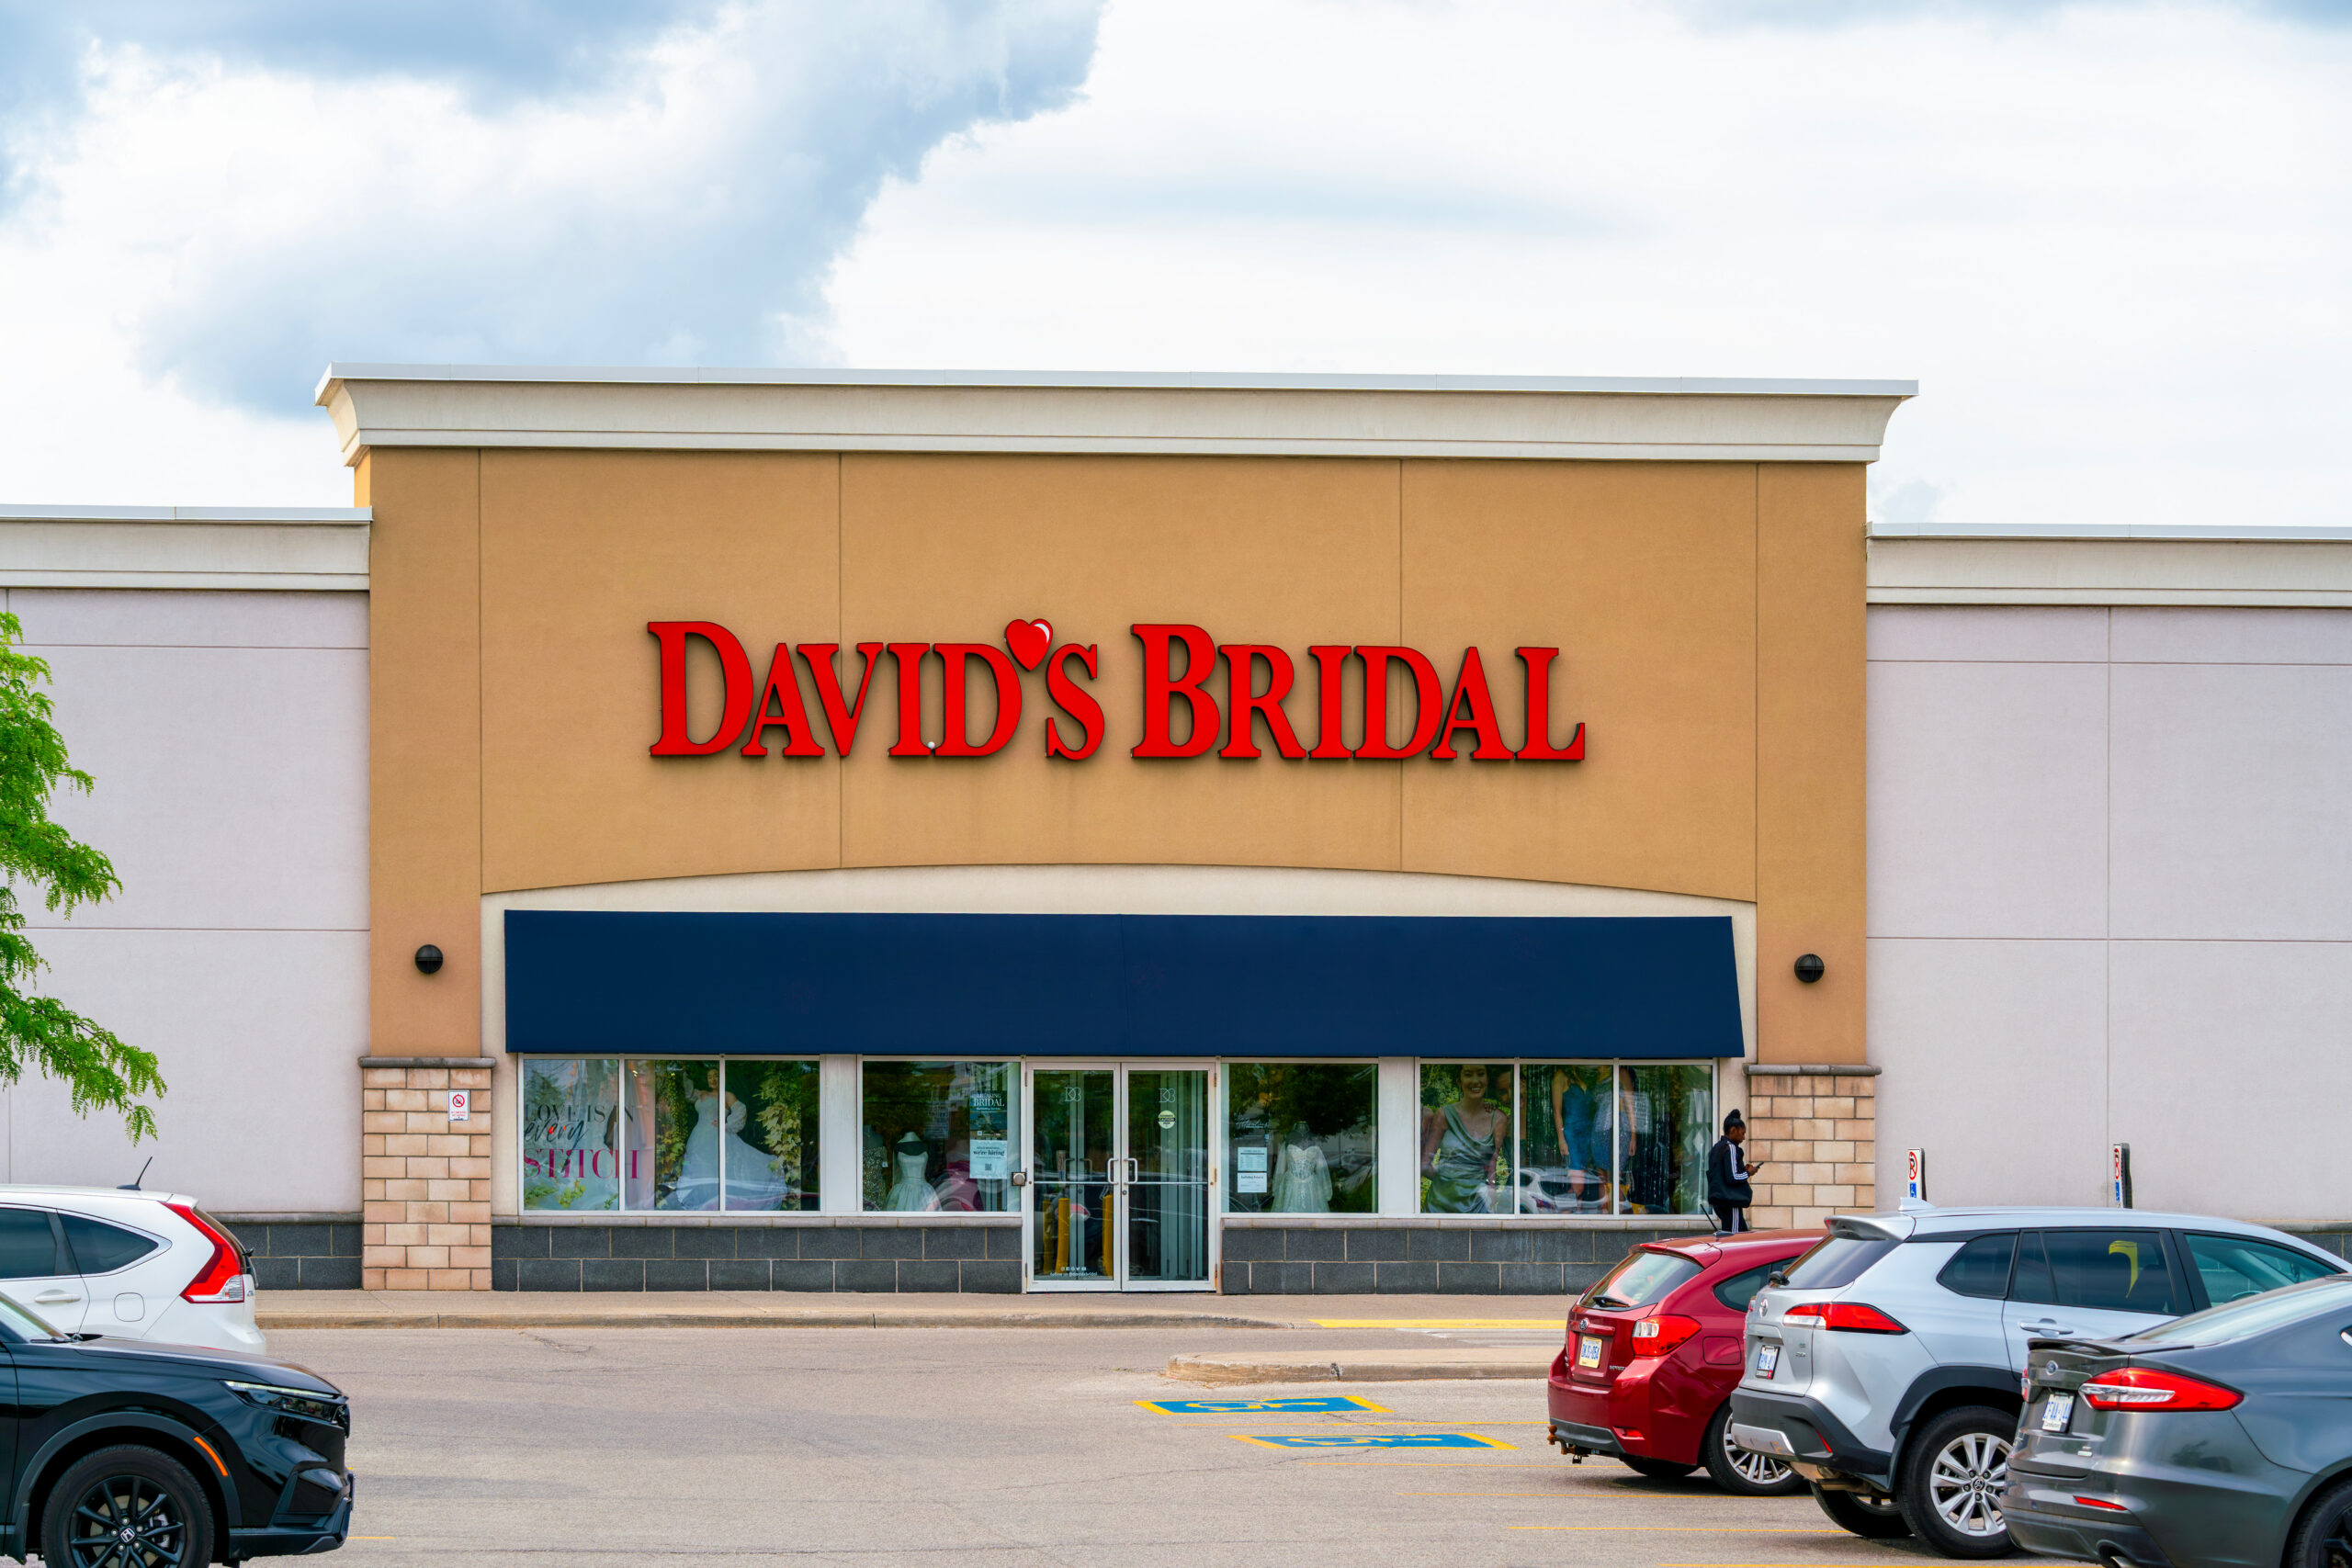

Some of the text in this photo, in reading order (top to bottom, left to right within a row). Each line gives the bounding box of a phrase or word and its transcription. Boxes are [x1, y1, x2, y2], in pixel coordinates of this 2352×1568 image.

[648, 619, 1587, 761] DAVID'S BRIDAL
[974, 1098, 1005, 1107] BRIDAL
[588, 1104, 606, 1122] IS
